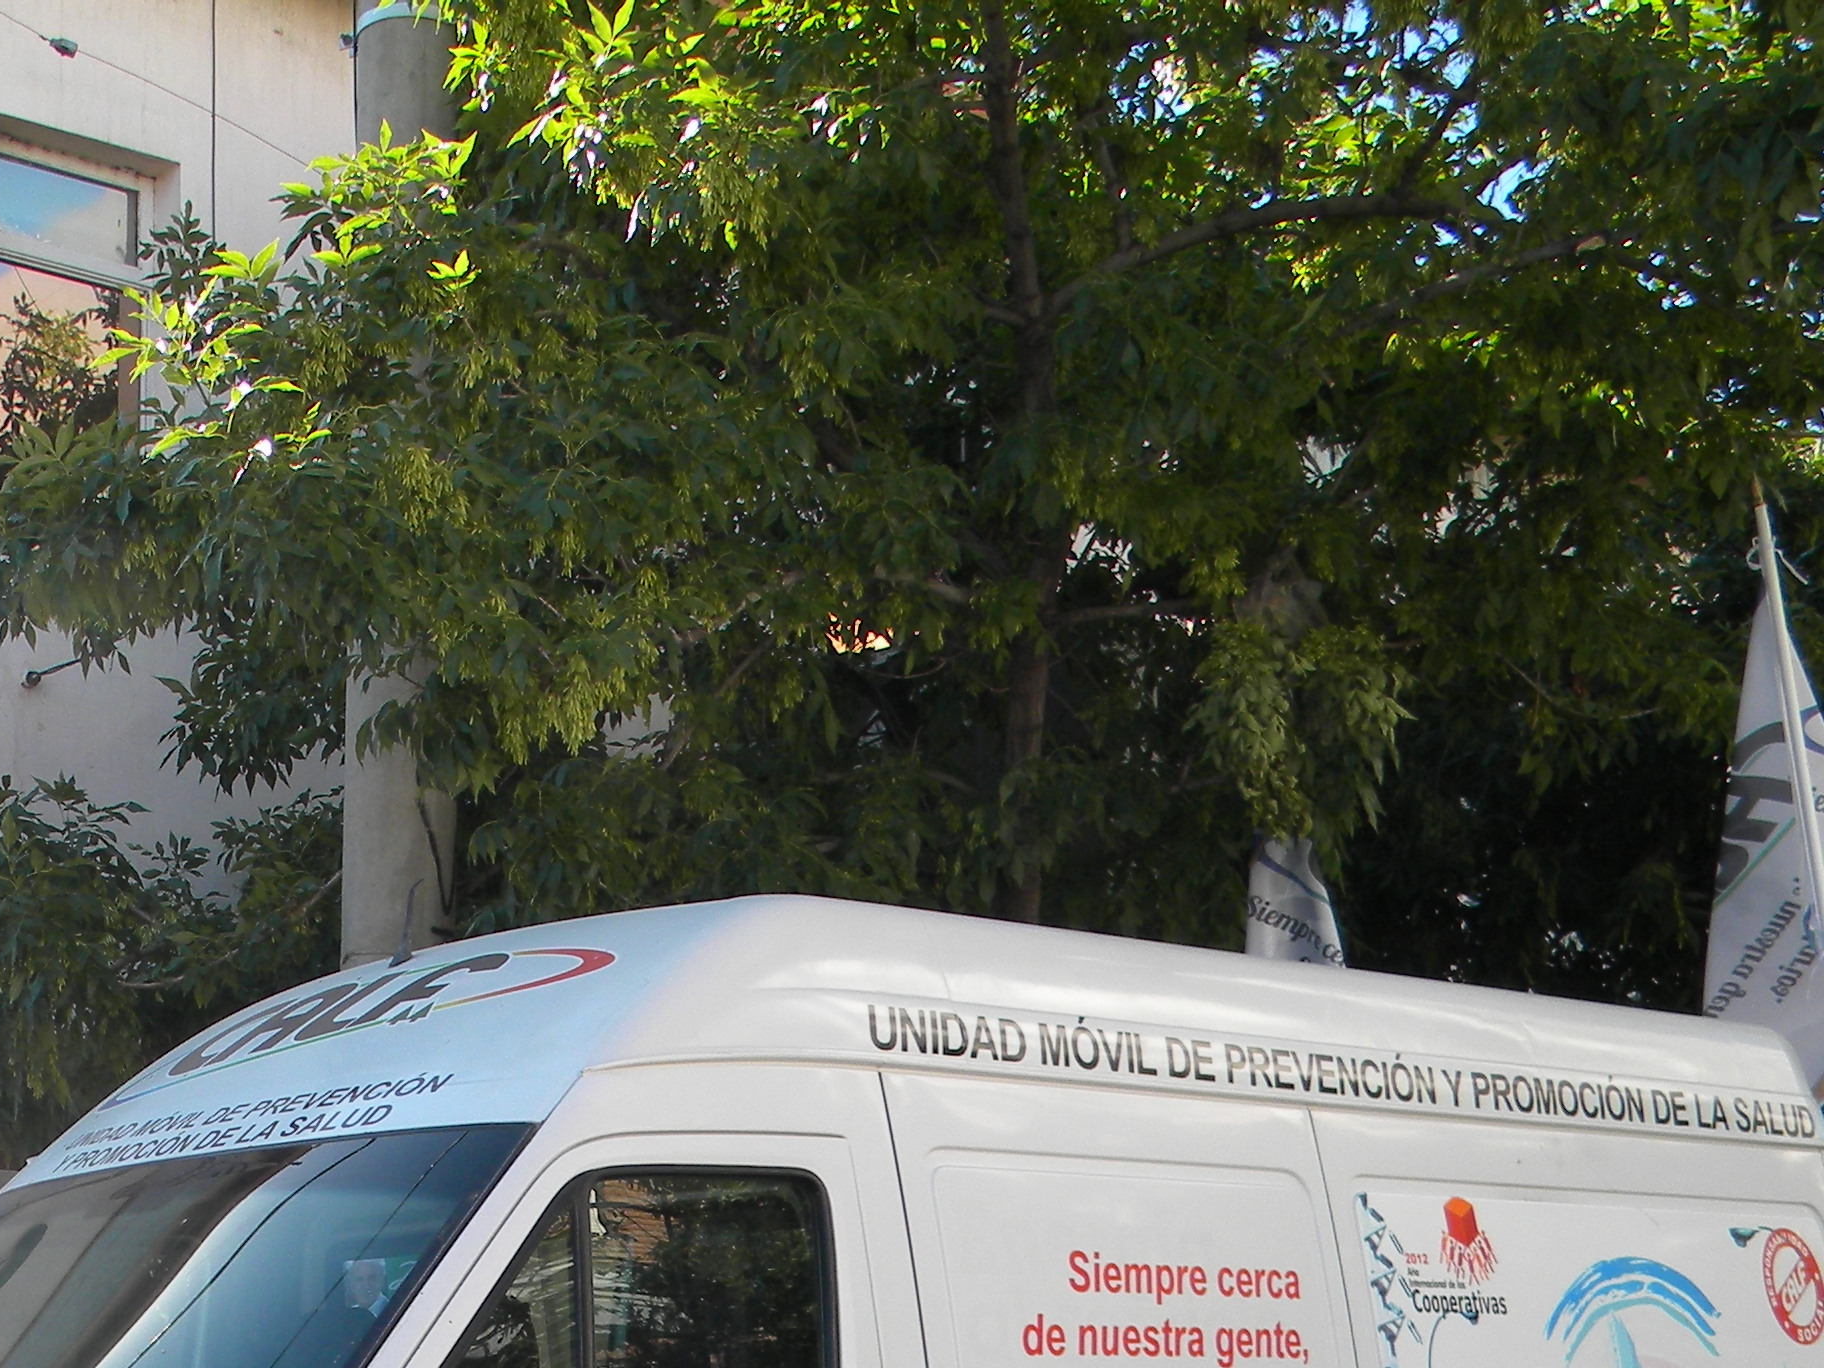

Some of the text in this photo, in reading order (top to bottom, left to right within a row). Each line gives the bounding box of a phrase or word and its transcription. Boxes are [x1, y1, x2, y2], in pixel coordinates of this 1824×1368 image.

[1248, 895, 1322, 950] Siempre
[167, 952, 511, 1077] CALF
[866, 1004, 1816, 1140] UNIDAD MÓVIL DE PREVENCIÓN Y PROMOCIÓN DE LA SALUD
[53, 1104, 394, 1173] Y PROMOCIÓN DE LA SALUD
[66, 1072, 455, 1150] UNIDAD MÓVIL DE PREVENCIÓN
[1069, 1250, 1300, 1304] Siempre cerca
[1405, 1253, 1429, 1265] 2012
[1781, 1260, 1807, 1312] CALF
[1412, 1289, 1508, 1318] Cooperativas
[1022, 1313, 1309, 1368] de nuestra gente,
